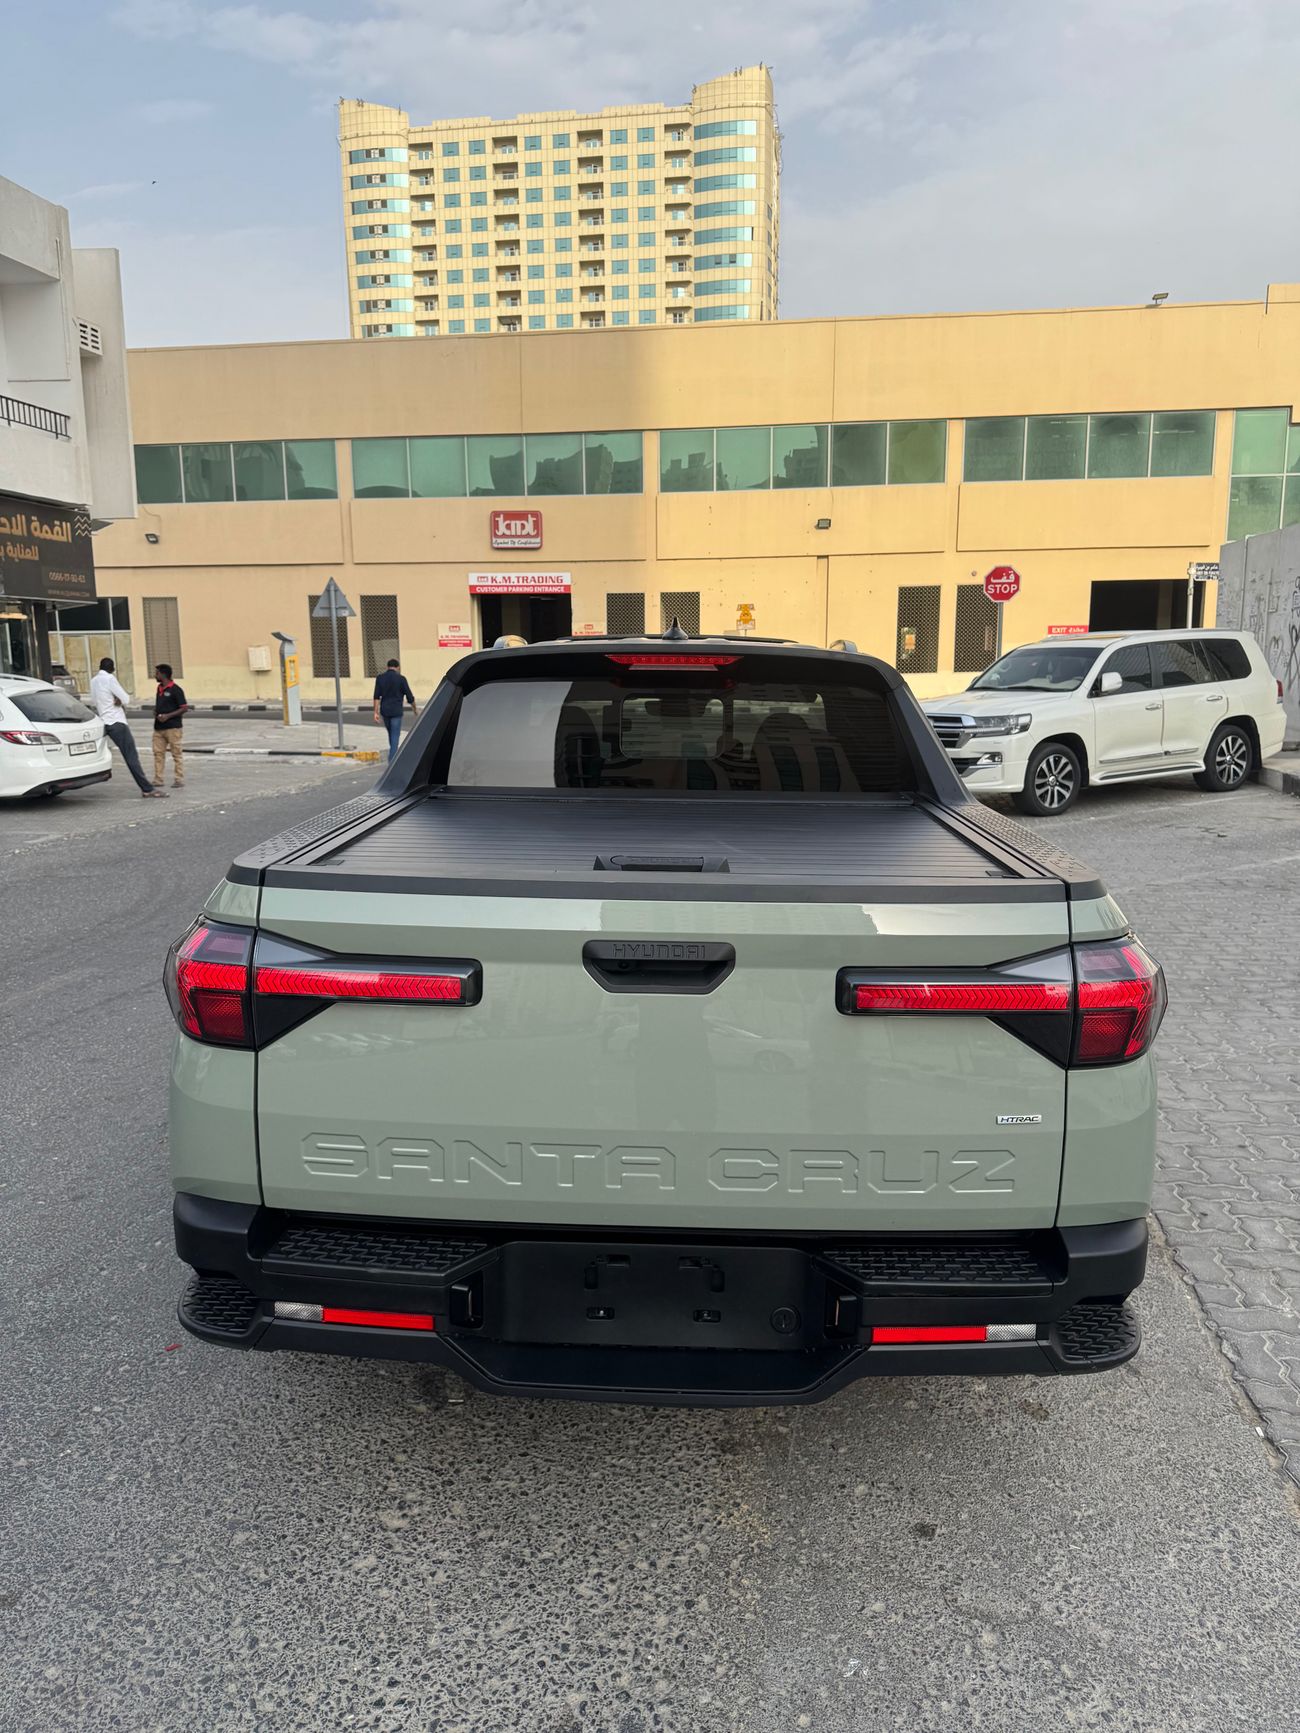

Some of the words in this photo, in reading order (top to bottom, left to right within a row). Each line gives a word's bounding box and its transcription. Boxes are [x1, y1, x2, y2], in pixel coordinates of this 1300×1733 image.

[30, 516, 72, 544] القمة
[990, 570, 1015, 583] قف
[987, 584, 1018, 594] STOP
[1051, 626, 1067, 634] EXIT
[612, 943, 706, 959] HYUNDAI
[301, 1132, 677, 1190] SANTA
[707, 1148, 1016, 1194] CRUZ
